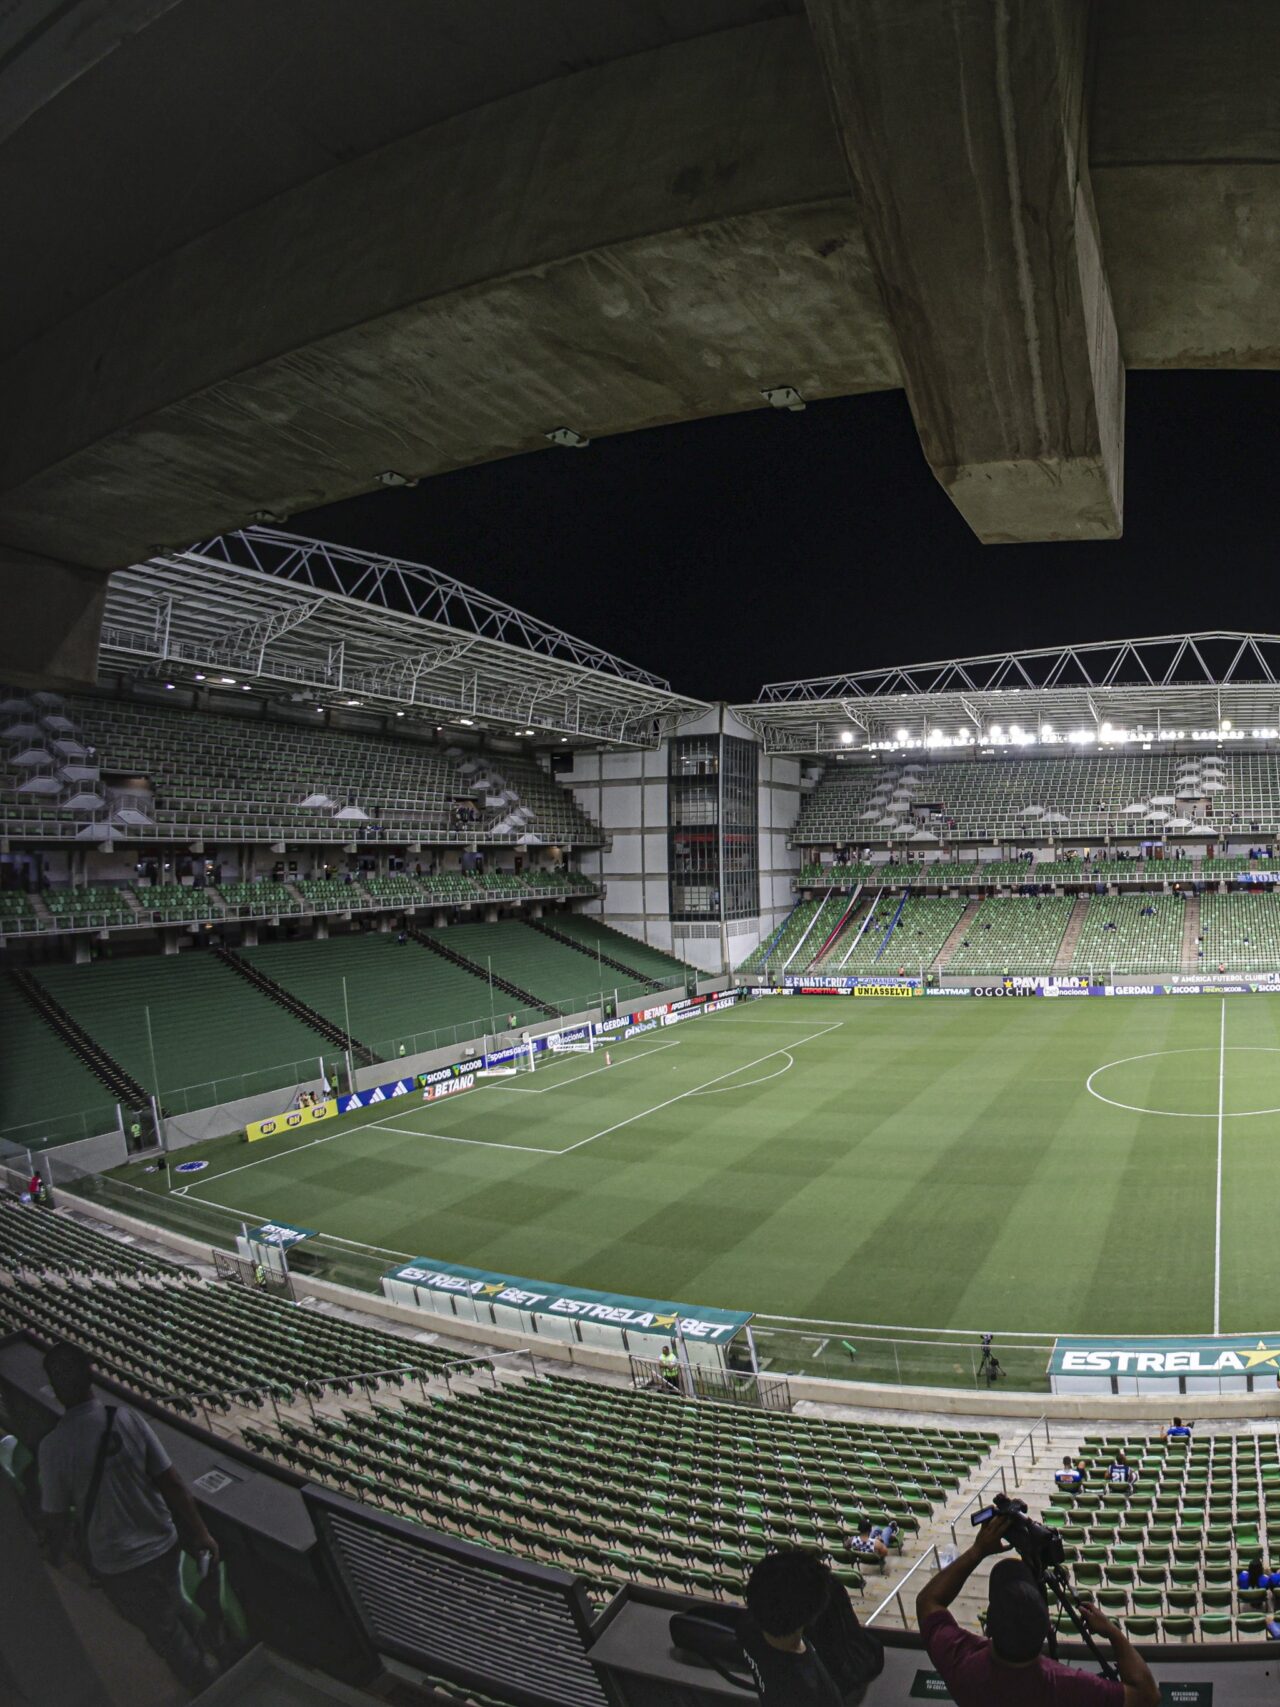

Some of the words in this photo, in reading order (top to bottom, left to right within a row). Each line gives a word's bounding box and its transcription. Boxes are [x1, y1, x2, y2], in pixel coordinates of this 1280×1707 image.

[858, 987, 910, 996] UNIASSELVI
[927, 988, 970, 996] HEATMAP
[974, 987, 1030, 996] OGOCHI
[1116, 986, 1154, 995] GERDAU
[644, 1005, 668, 1021] BETANO
[603, 1016, 629, 1031] GERDAU
[427, 1068, 451, 1083] SICOOB
[460, 1059, 482, 1073] SICOOB
[435, 1074, 474, 1098] BETANO
[396, 1267, 484, 1294] ESTRELA
[497, 1287, 548, 1306] BET
[549, 1298, 654, 1327] ESTRELA
[677, 1319, 735, 1338] BET
[1060, 1350, 1238, 1372] ESTRELA
[1111, 1472, 1126, 1482] 21
